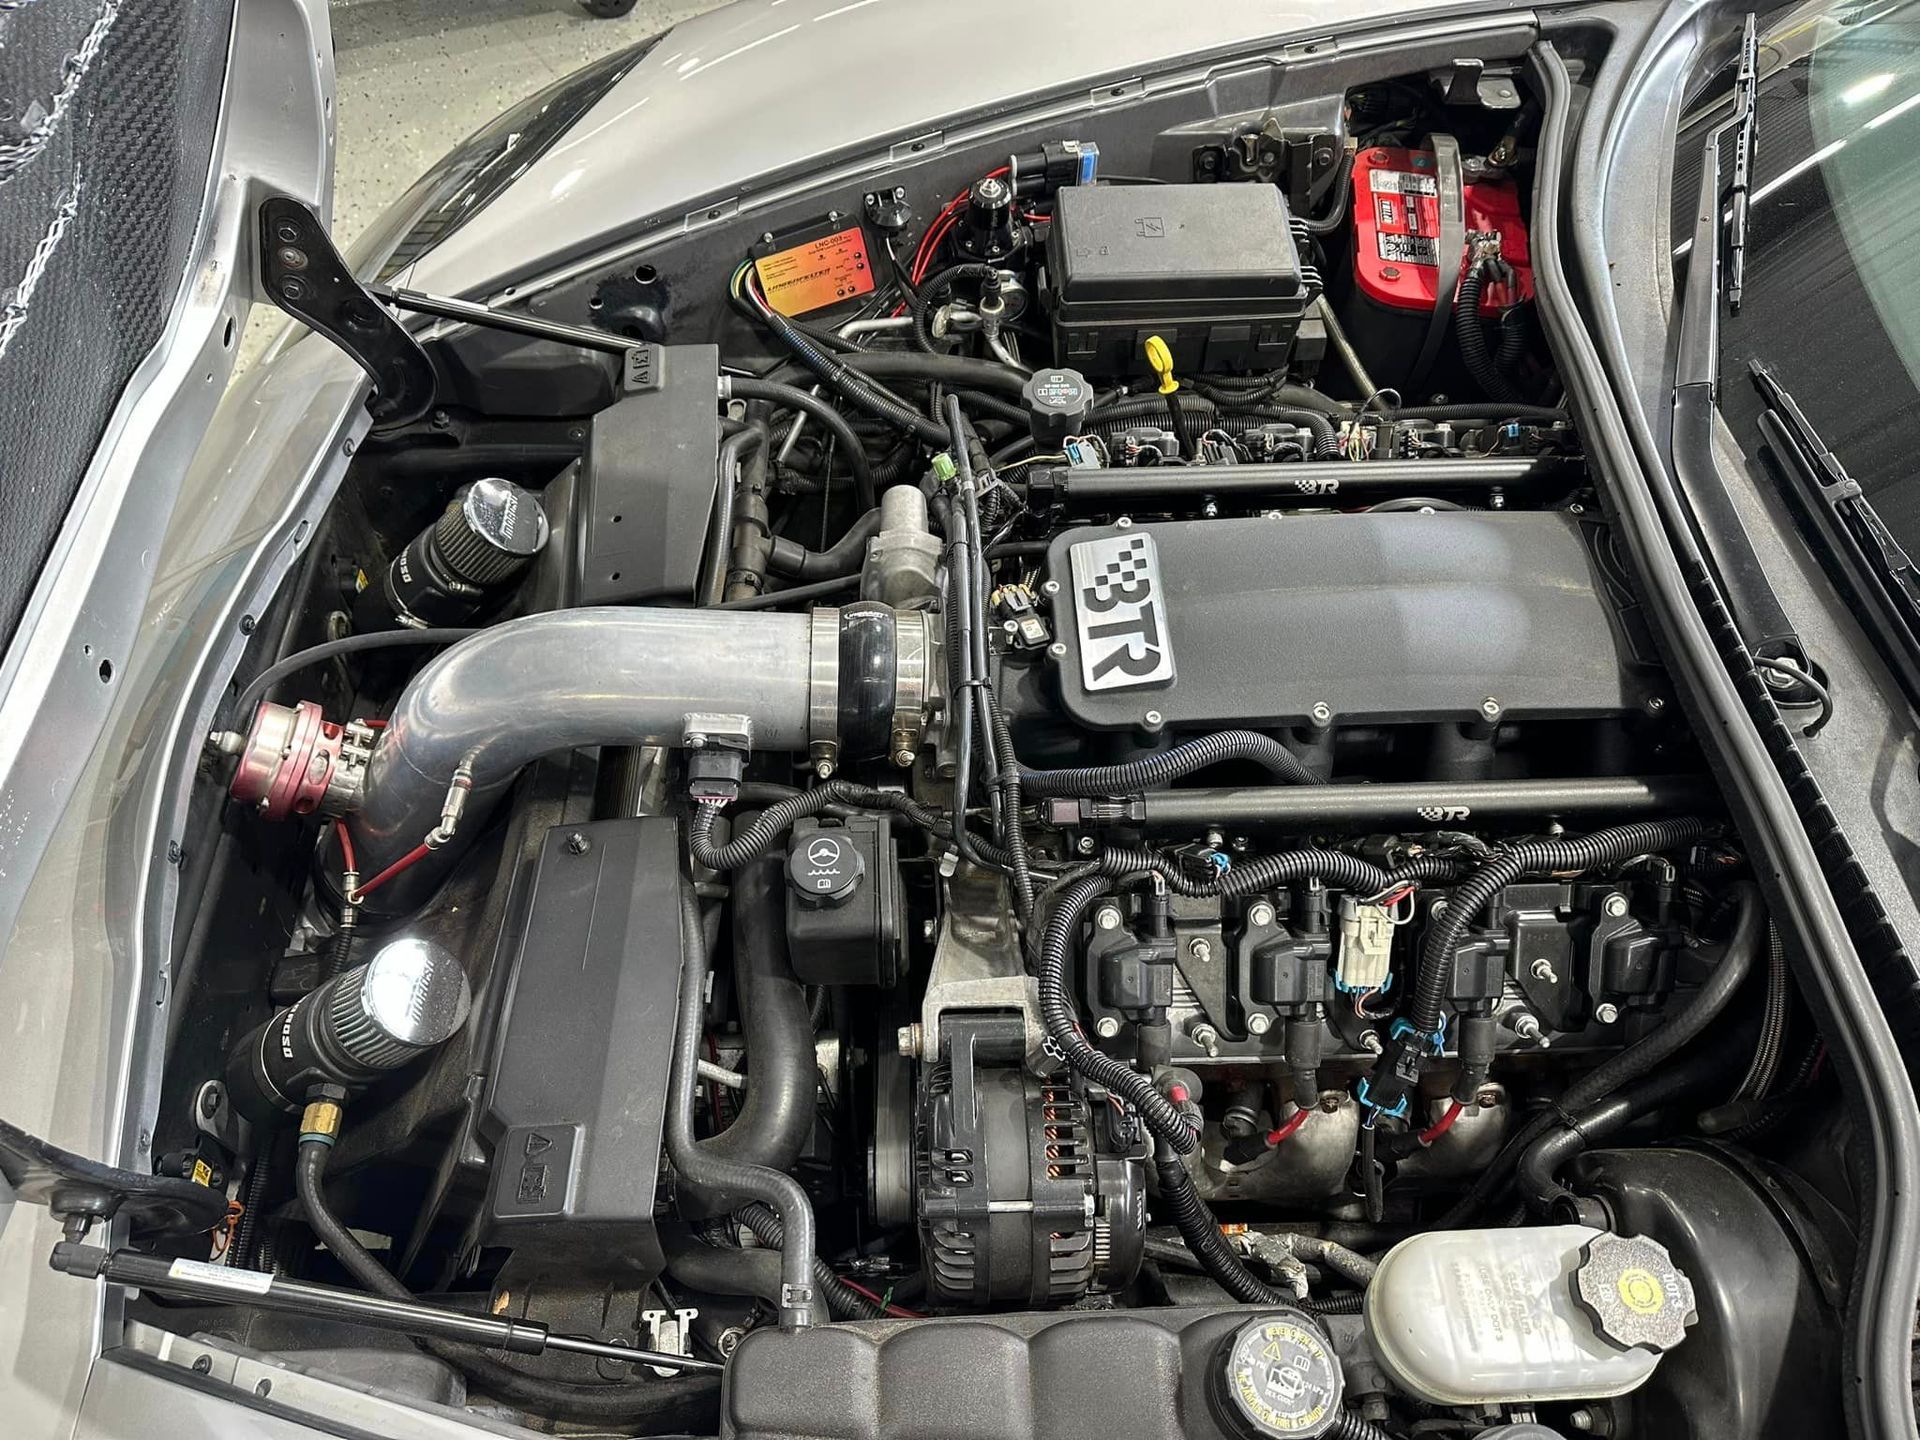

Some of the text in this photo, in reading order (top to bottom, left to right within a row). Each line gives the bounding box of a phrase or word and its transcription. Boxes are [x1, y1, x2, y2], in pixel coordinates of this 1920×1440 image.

[1297, 478, 1340, 495] BTR
[1083, 572, 1161, 681] BTR
[1419, 805, 1471, 821] BTR
